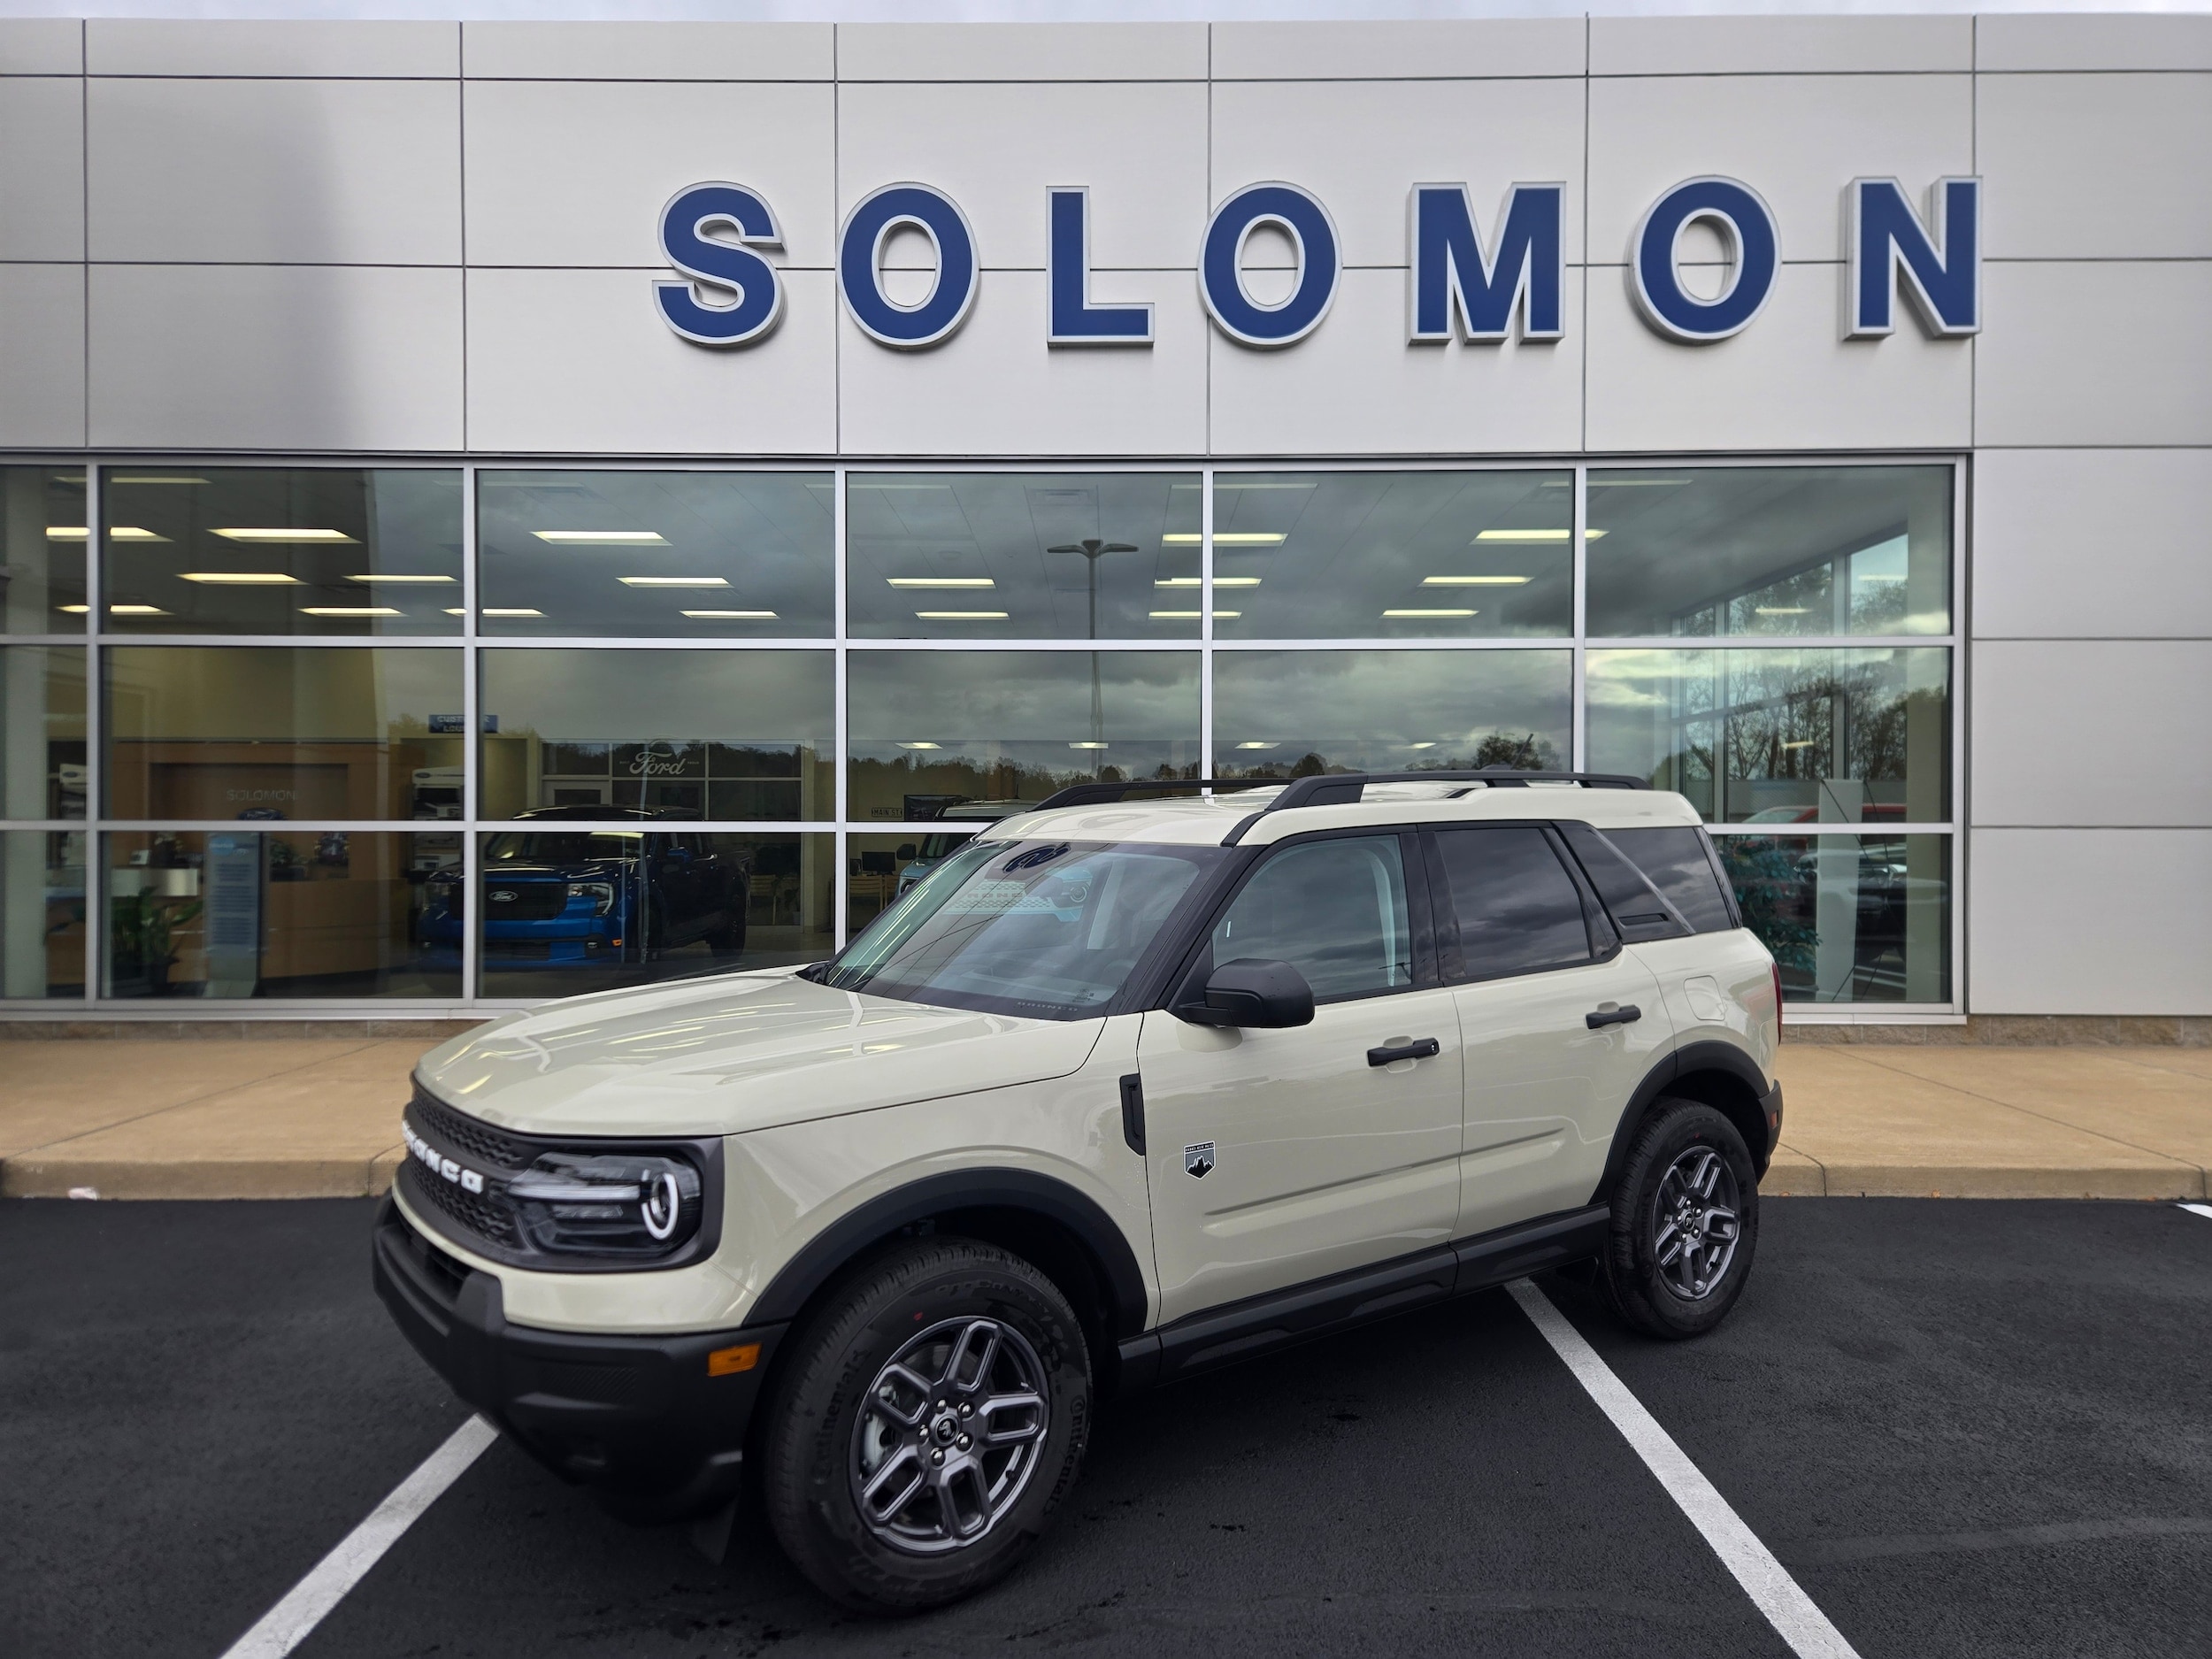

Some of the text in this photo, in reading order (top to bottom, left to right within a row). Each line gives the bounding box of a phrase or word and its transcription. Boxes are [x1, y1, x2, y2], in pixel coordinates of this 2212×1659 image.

[651, 174, 1983, 350] SOLOMON
[226, 789, 298, 801] SOLOMON
[629, 751, 687, 775] Ford
[1049, 1394, 1087, 1502] Continental
